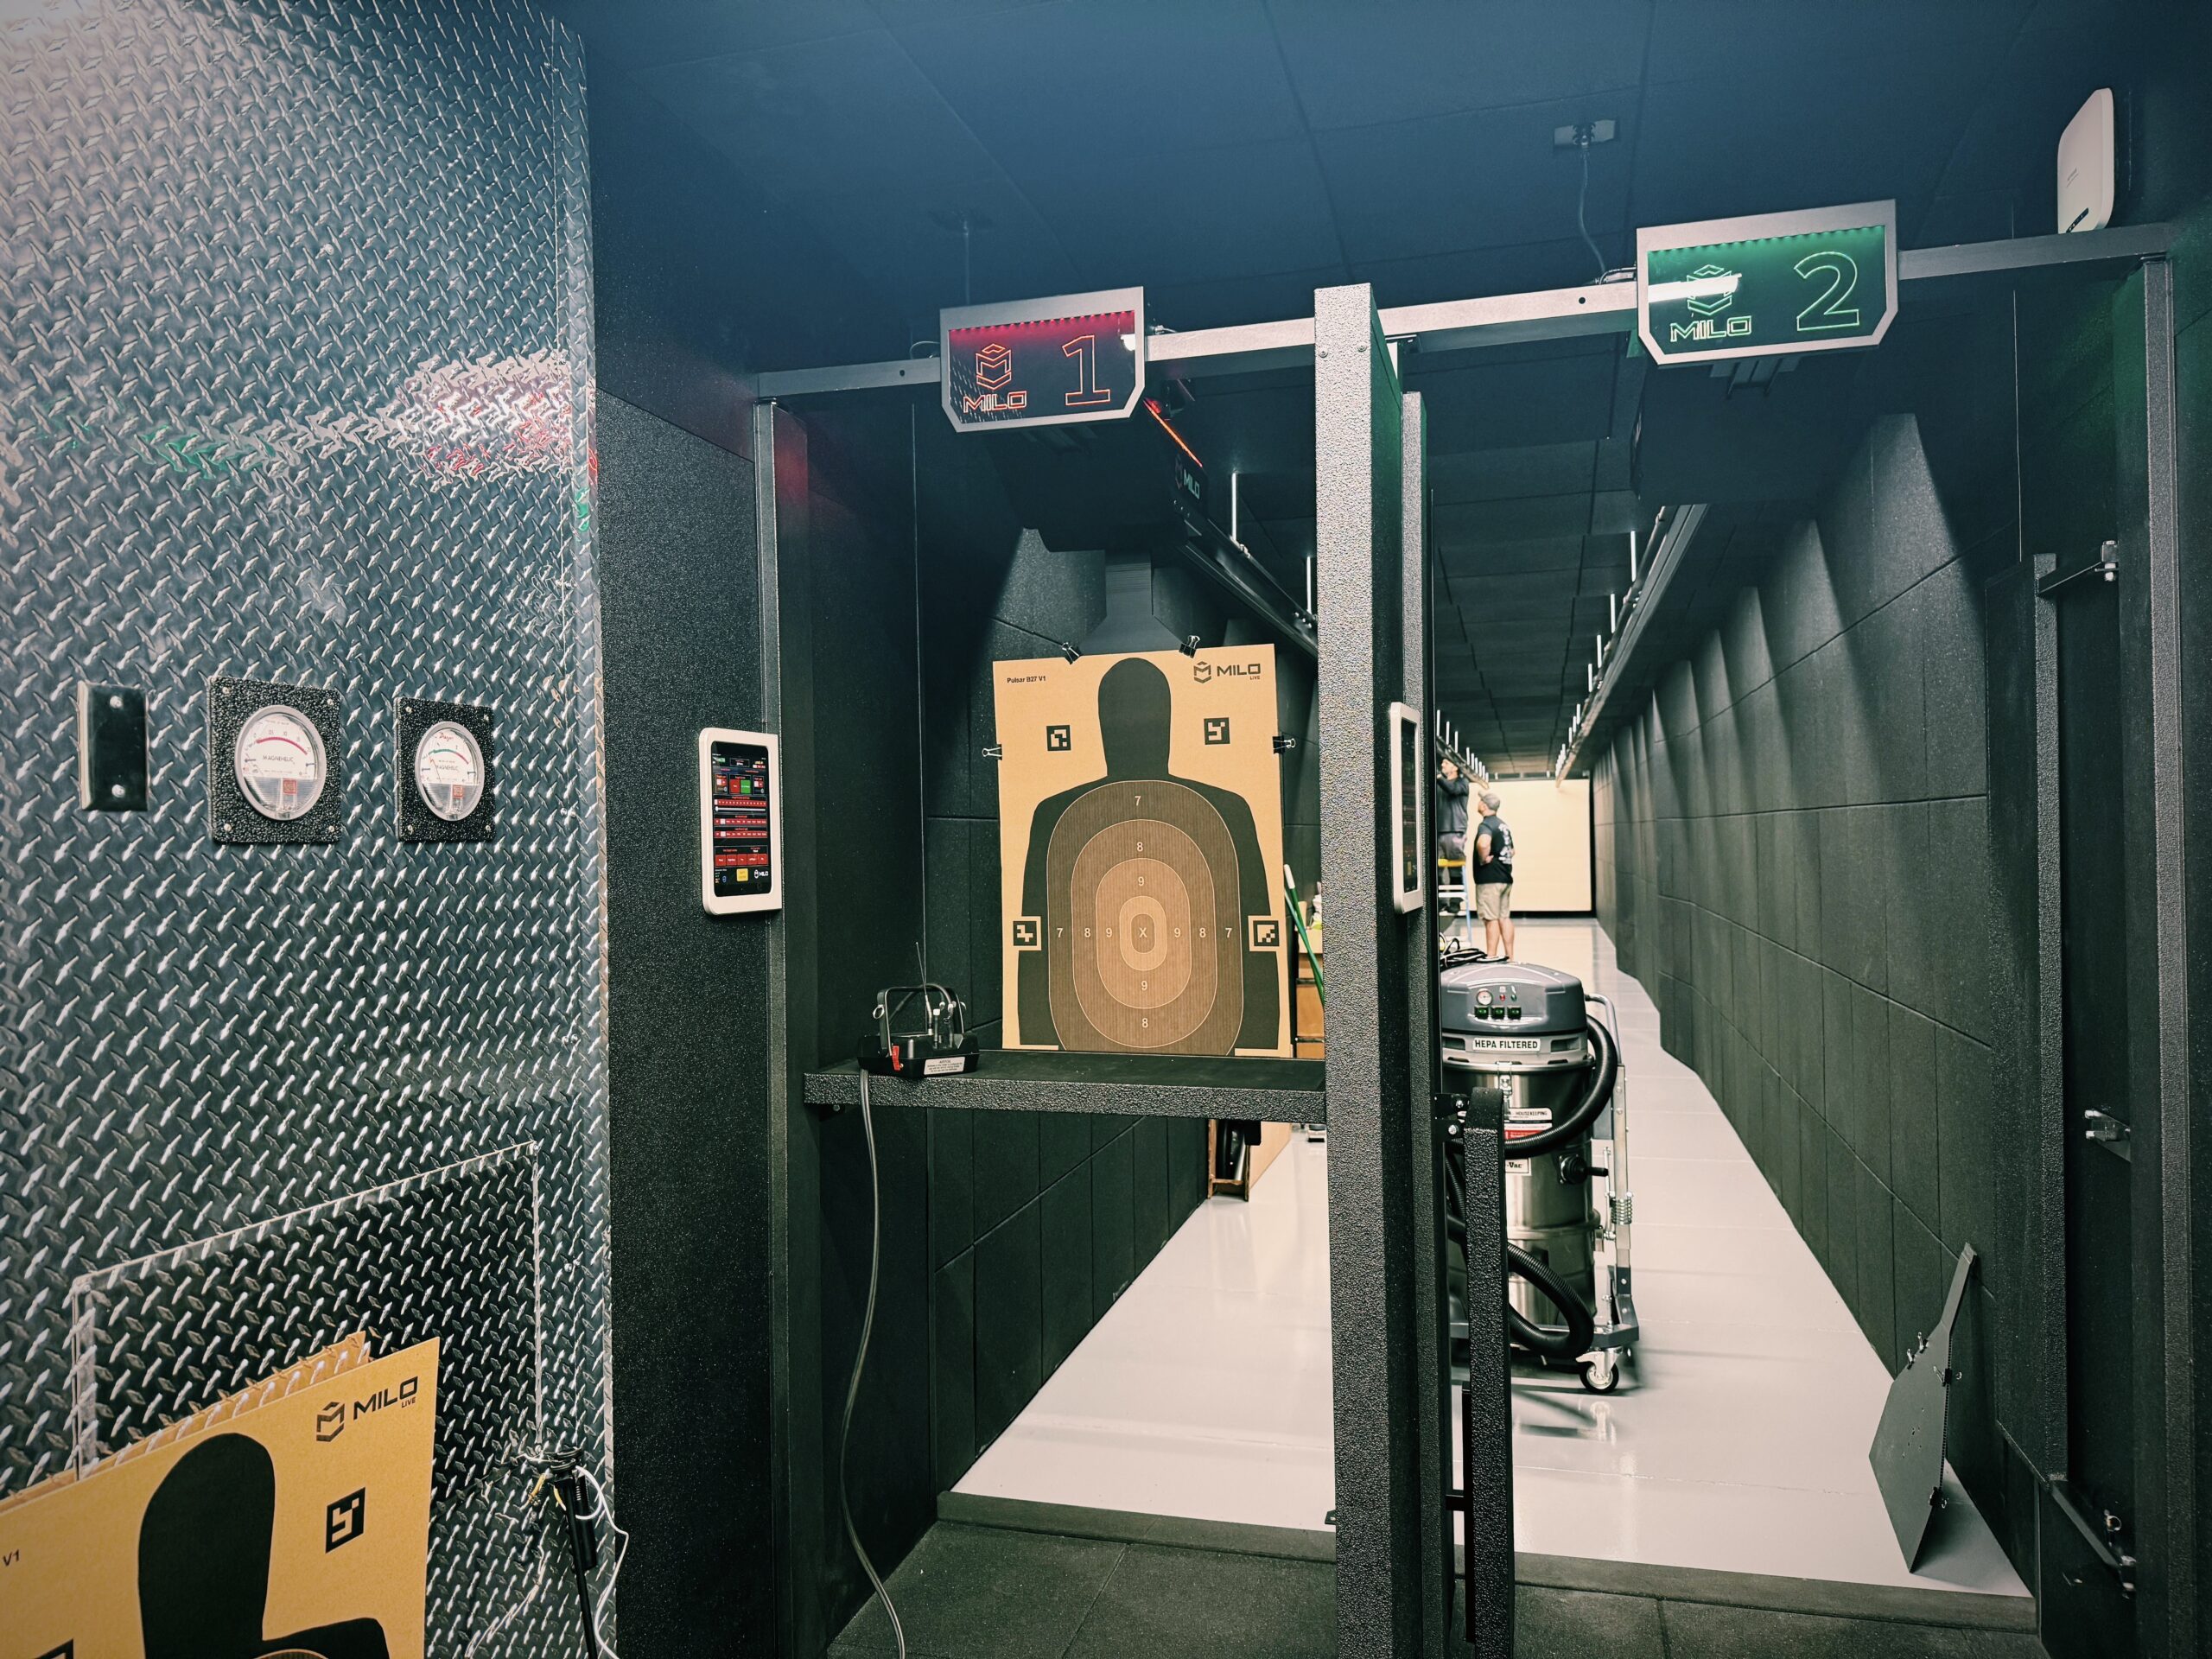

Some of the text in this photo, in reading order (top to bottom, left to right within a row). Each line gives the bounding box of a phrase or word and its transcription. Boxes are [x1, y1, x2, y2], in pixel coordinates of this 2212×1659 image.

[1794, 251, 1859, 331] 2
[1670, 315, 1751, 342] MILO
[1062, 334, 1110, 406] 1
[963, 391, 1027, 413] MILO
[1184, 469, 1200, 499] MILO
[1217, 664, 1261, 677] MILO
[1135, 796, 1141, 806] 7
[1136, 842, 1143, 852] 8
[1138, 876, 1145, 887] 9
[1057, 927, 1232, 938] 7 8 9 X 9 8 7
[1141, 981, 1147, 991] 9
[1141, 1018, 1148, 1028] 8
[1475, 1039, 1538, 1049] HEPA FILTERED
[353, 1376, 418, 1421] MILO
[401, 1397, 416, 1408] LIVE
[3, 1548, 19, 1567] V1
